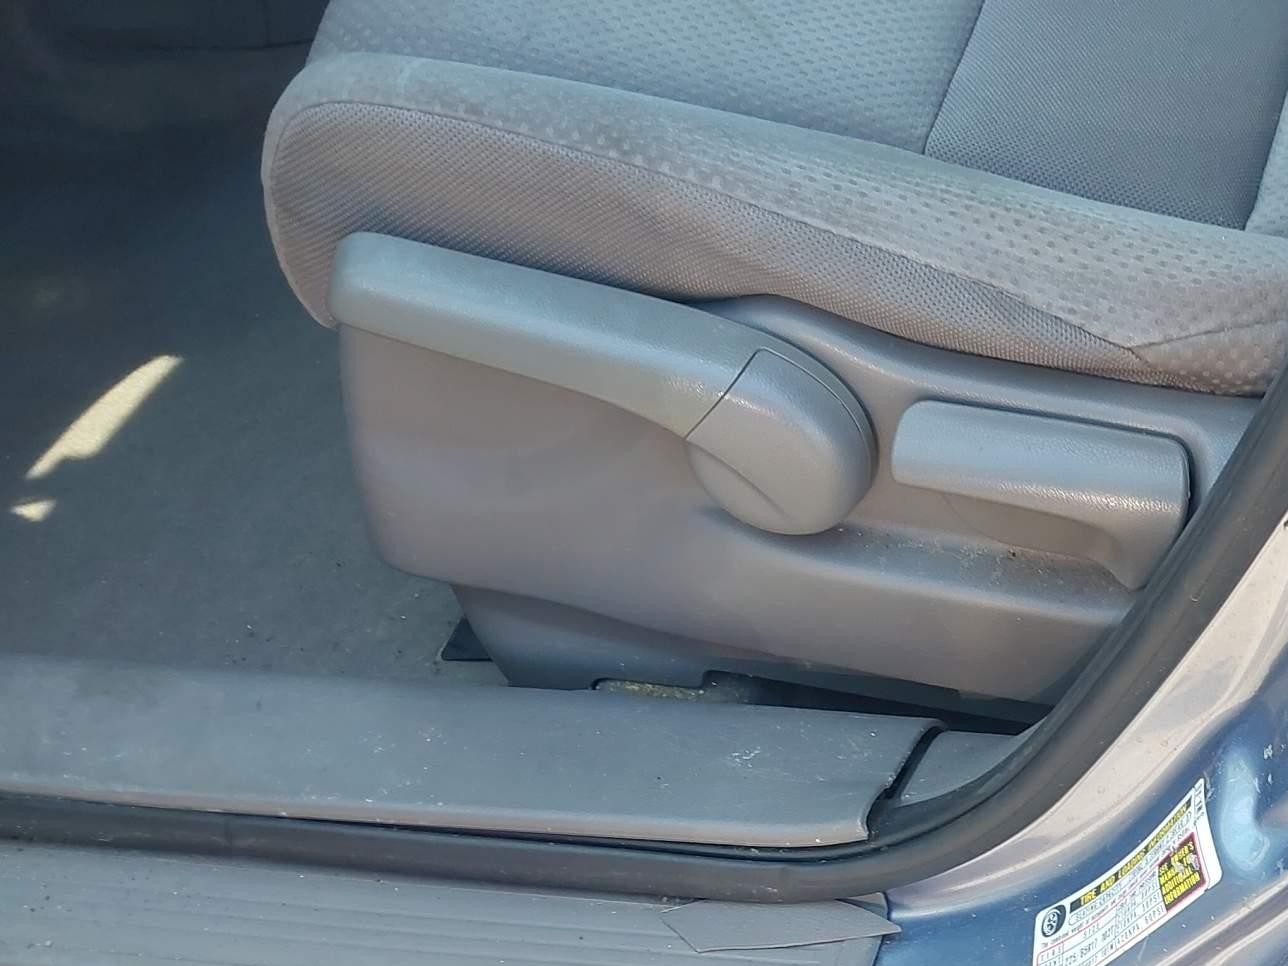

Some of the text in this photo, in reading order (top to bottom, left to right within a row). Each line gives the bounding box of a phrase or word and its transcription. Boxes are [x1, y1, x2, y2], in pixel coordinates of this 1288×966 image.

[1081, 889, 1097, 906] TIRE
[1100, 876, 1116, 892] AND
[1164, 871, 1200, 905] INFORMATION
